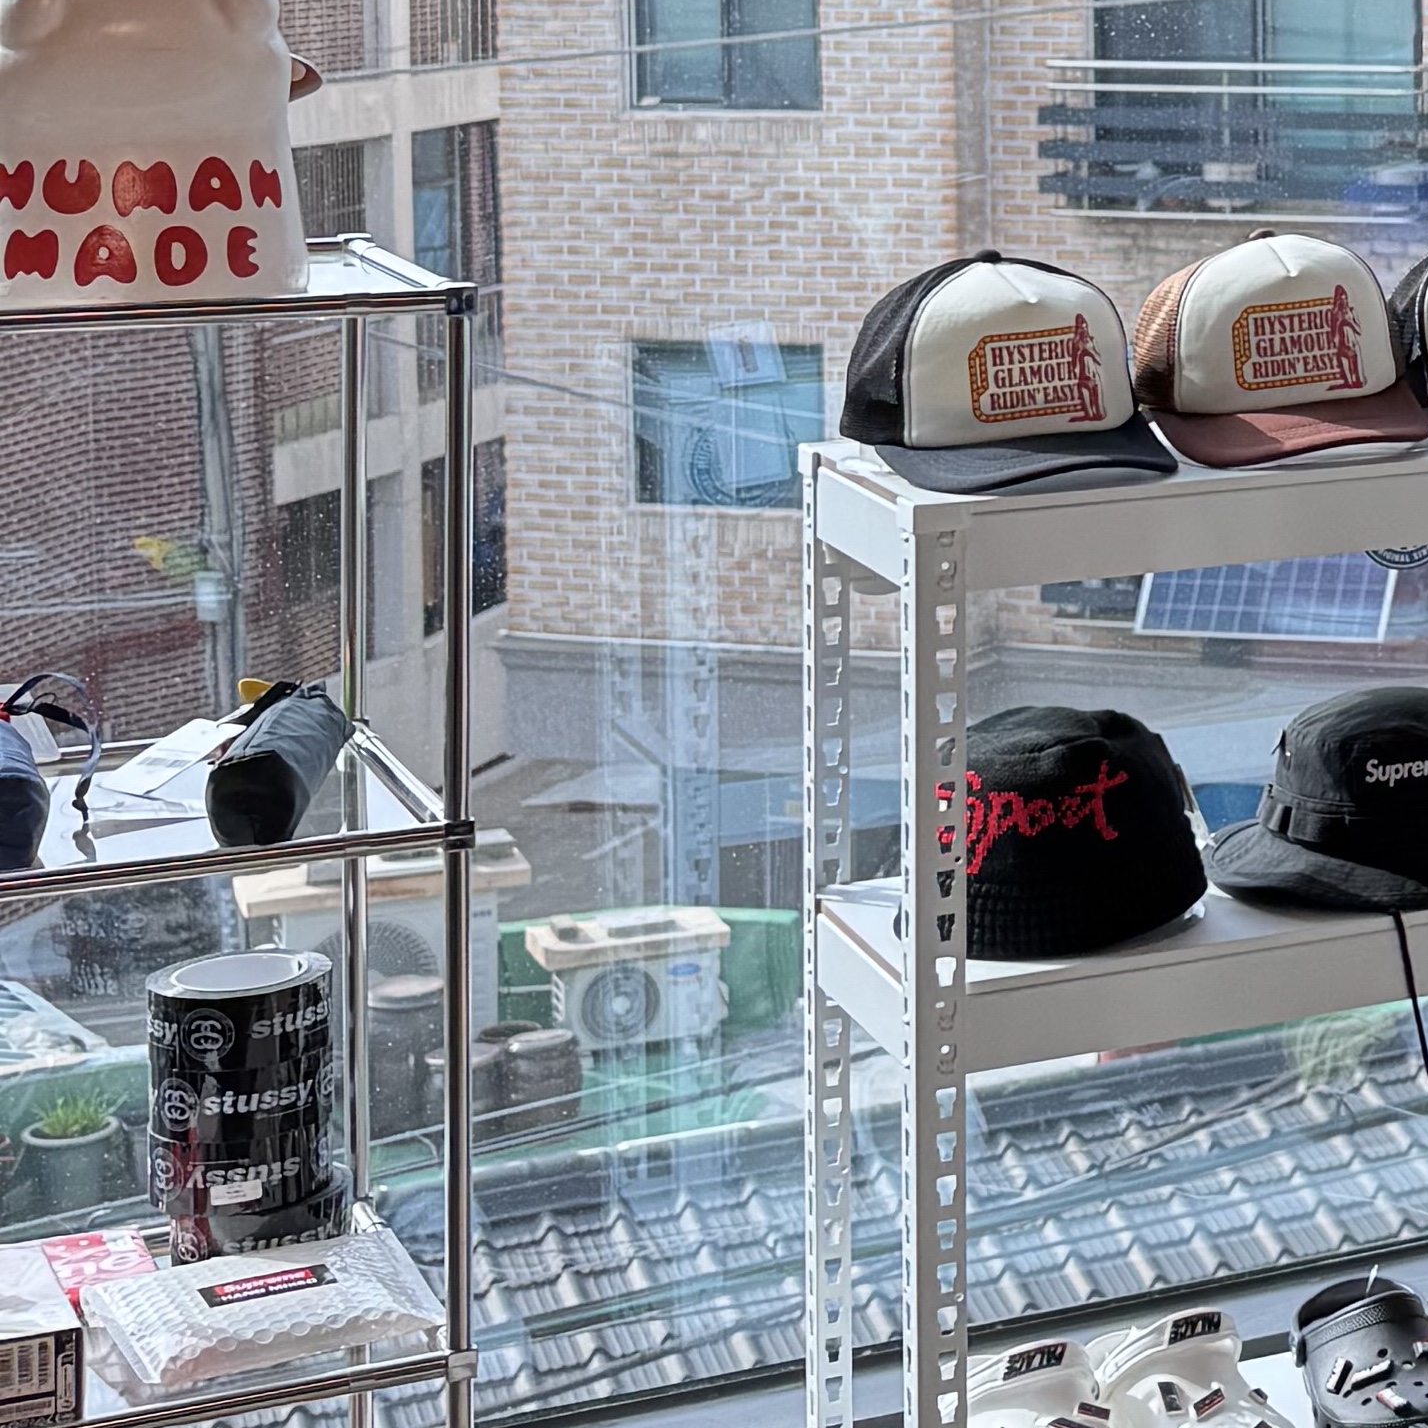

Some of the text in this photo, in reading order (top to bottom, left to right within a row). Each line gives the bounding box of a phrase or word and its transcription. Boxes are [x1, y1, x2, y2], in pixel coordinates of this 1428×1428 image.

[4, 224, 260, 287] MADE
[1255, 331, 1338, 359] GLAMOUR
[993, 361, 1078, 389] GLAMOUR
